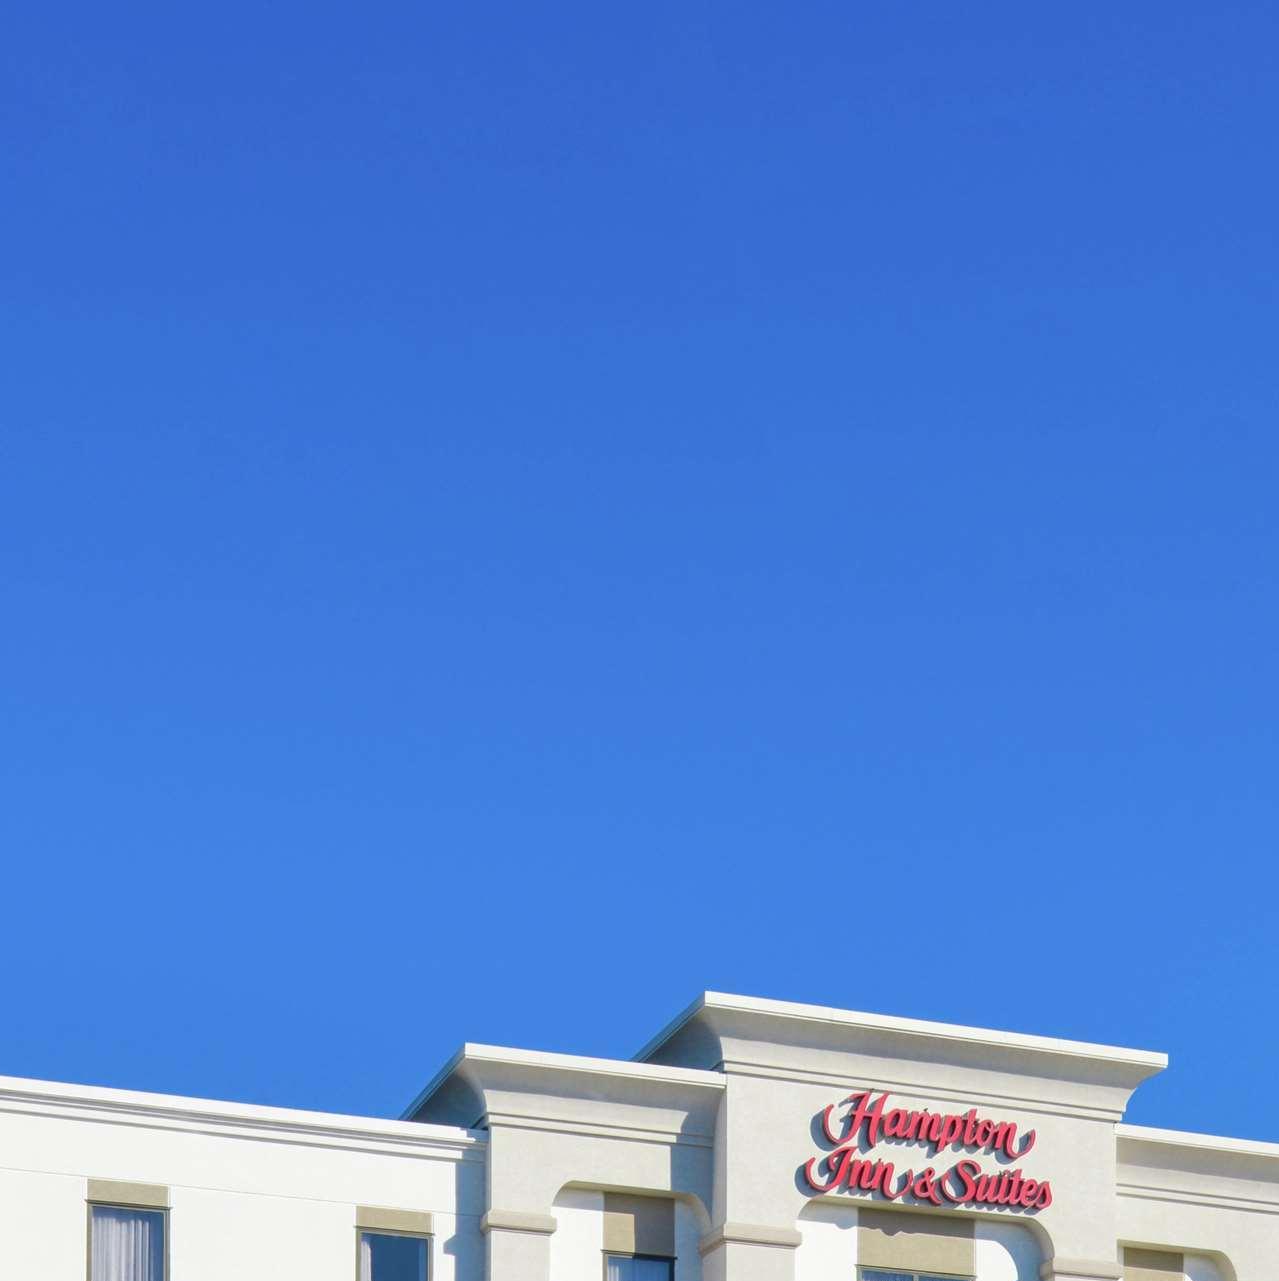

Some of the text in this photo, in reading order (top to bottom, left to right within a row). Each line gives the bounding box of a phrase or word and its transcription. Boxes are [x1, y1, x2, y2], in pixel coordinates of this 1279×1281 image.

[823, 1089, 1036, 1160] Hampton
[805, 1145, 1053, 1210] Inn & Suites
